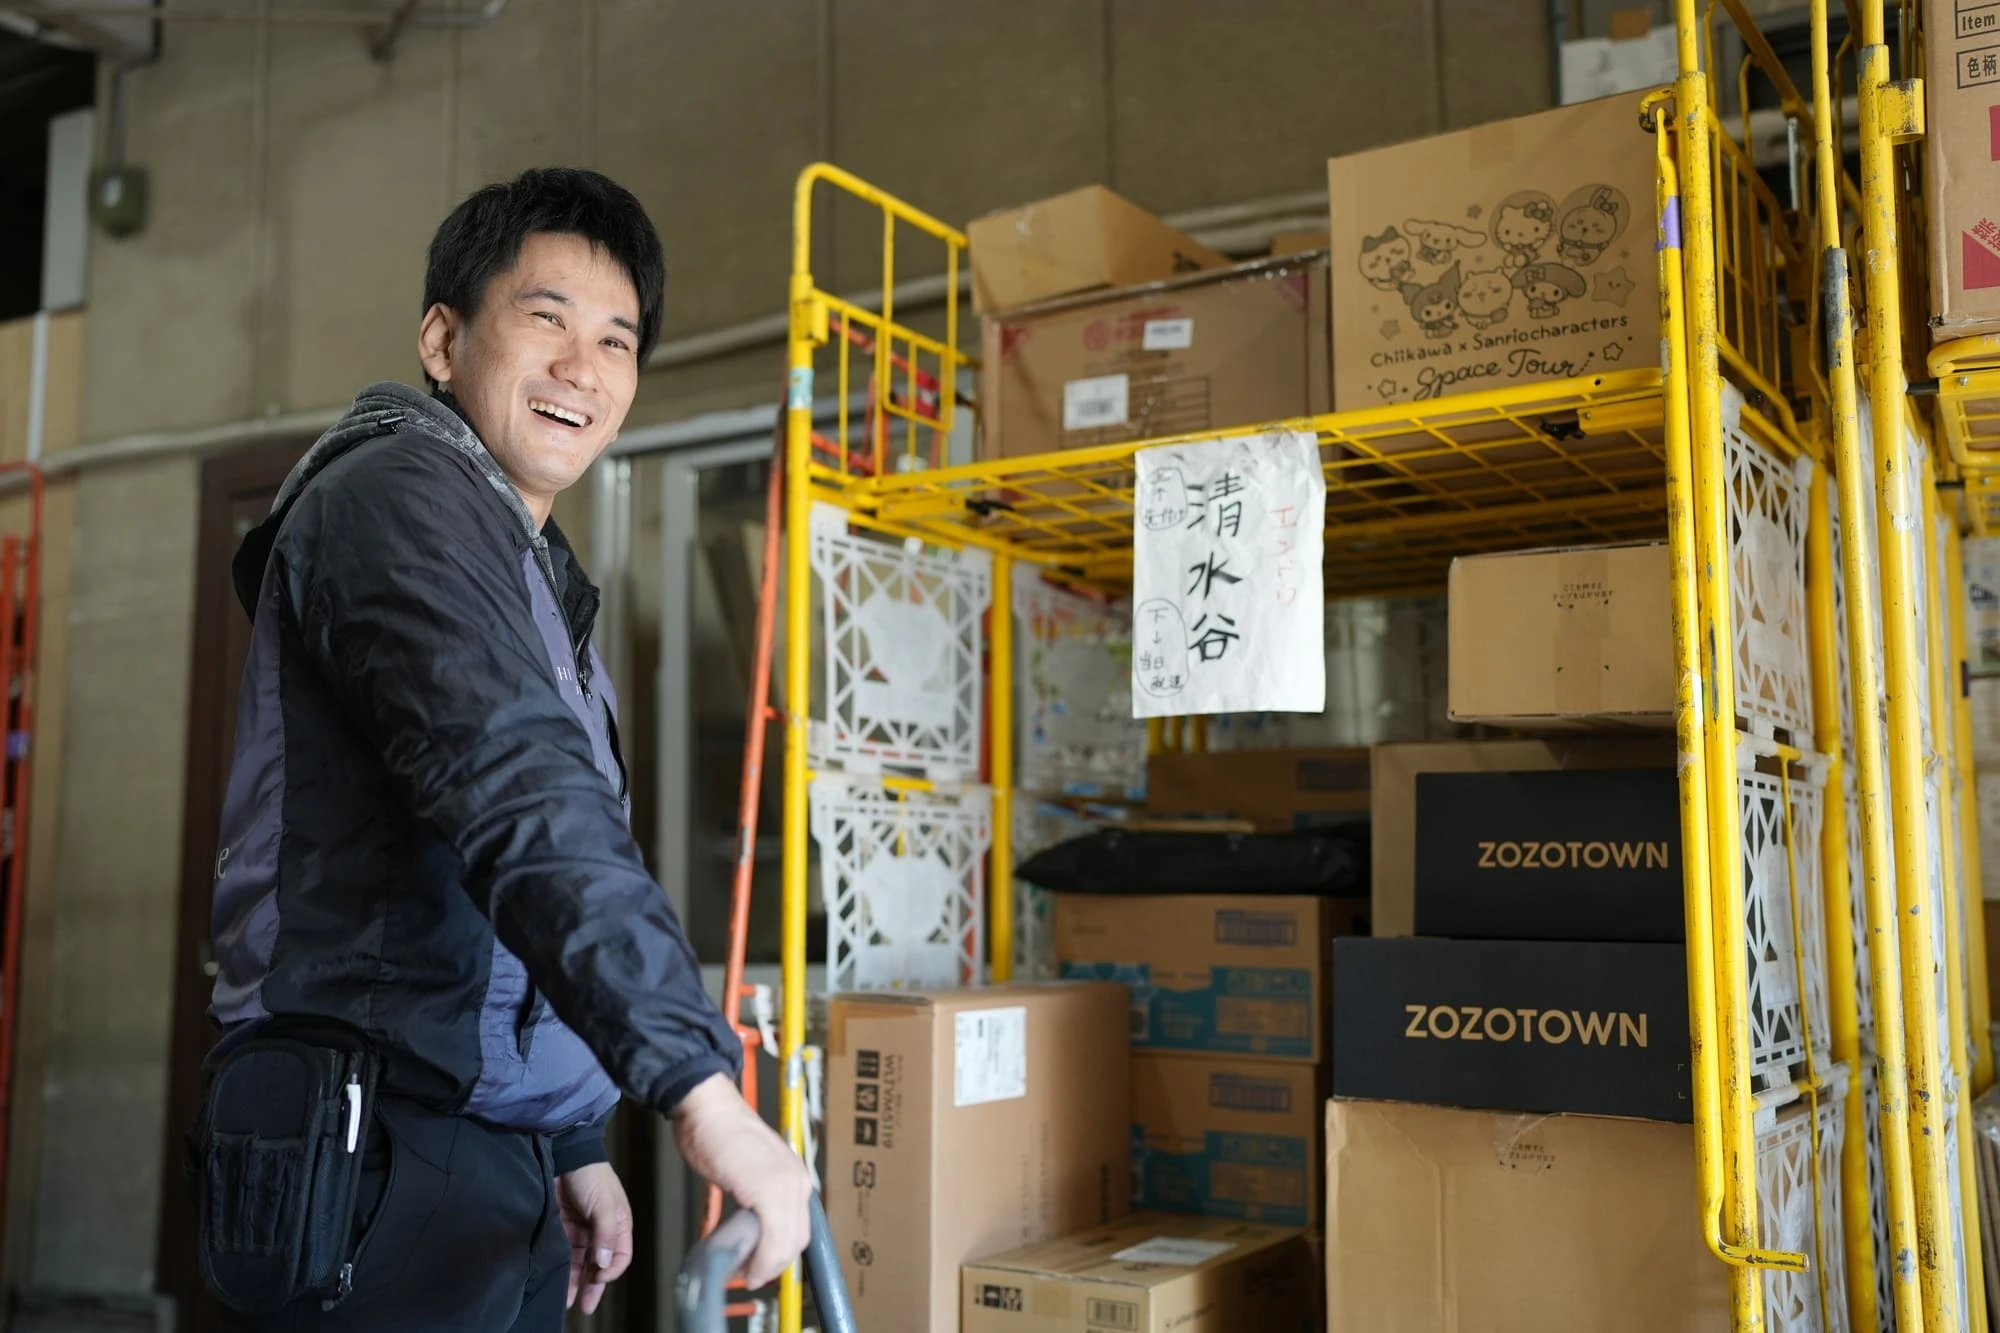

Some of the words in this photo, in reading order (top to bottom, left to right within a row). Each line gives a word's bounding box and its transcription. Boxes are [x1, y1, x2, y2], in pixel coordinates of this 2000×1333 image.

[1962, 14, 1996, 32] Item
[1967, 53, 1998, 79] 色柄
[1370, 343, 1453, 368] Chiikawa
[1473, 315, 1629, 350] Sanriocharacters
[1413, 361, 1502, 401] Space
[1507, 348, 1580, 378] Tour
[1187, 472, 1244, 662] 清水谷
[1140, 650, 1164, 671] 当日
[1478, 841, 1669, 869] ZOZOTOWN
[1405, 1004, 1648, 1048] ZOZOTOWN
